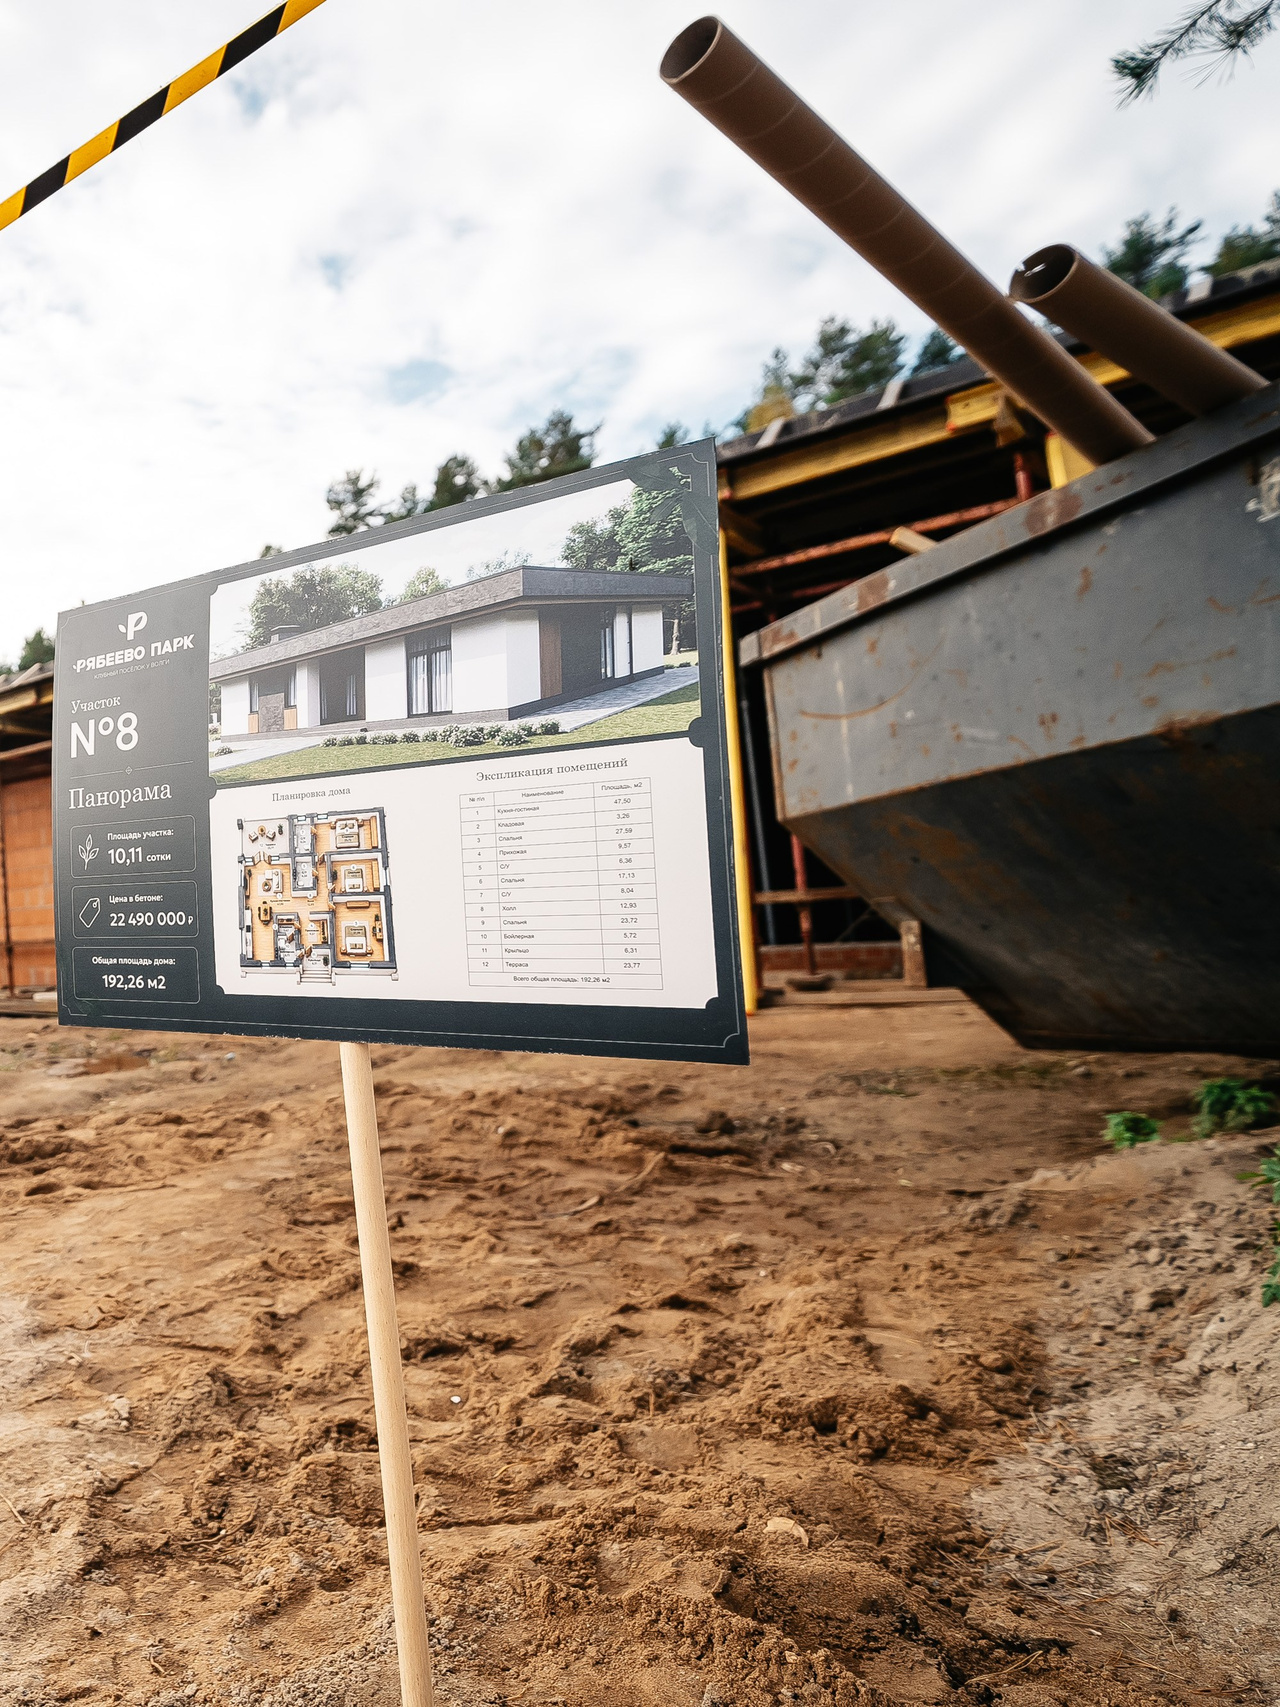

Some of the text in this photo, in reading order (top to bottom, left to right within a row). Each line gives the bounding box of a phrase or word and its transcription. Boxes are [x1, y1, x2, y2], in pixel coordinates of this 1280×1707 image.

[73, 634, 194, 673] РЯБЕЕВО ПАРК
[151, 659, 169, 668] ВОЛГИ
[71, 697, 120, 713] Участок
[476, 758, 628, 782] Экспликация помещений
[69, 784, 172, 809] Панорама
[272, 788, 350, 801] Планировка дома
[522, 789, 564, 798] Наименование
[497, 806, 539, 814] Кухня-гостиная
[143, 829, 174, 839] участка:
[108, 847, 171, 866] 10,11 сотки
[110, 895, 127, 903] Цена
[110, 913, 125, 926] 22
[128, 912, 153, 926] 490
[157, 912, 185, 925] 000
[102, 975, 166, 990] 192,26 м2
